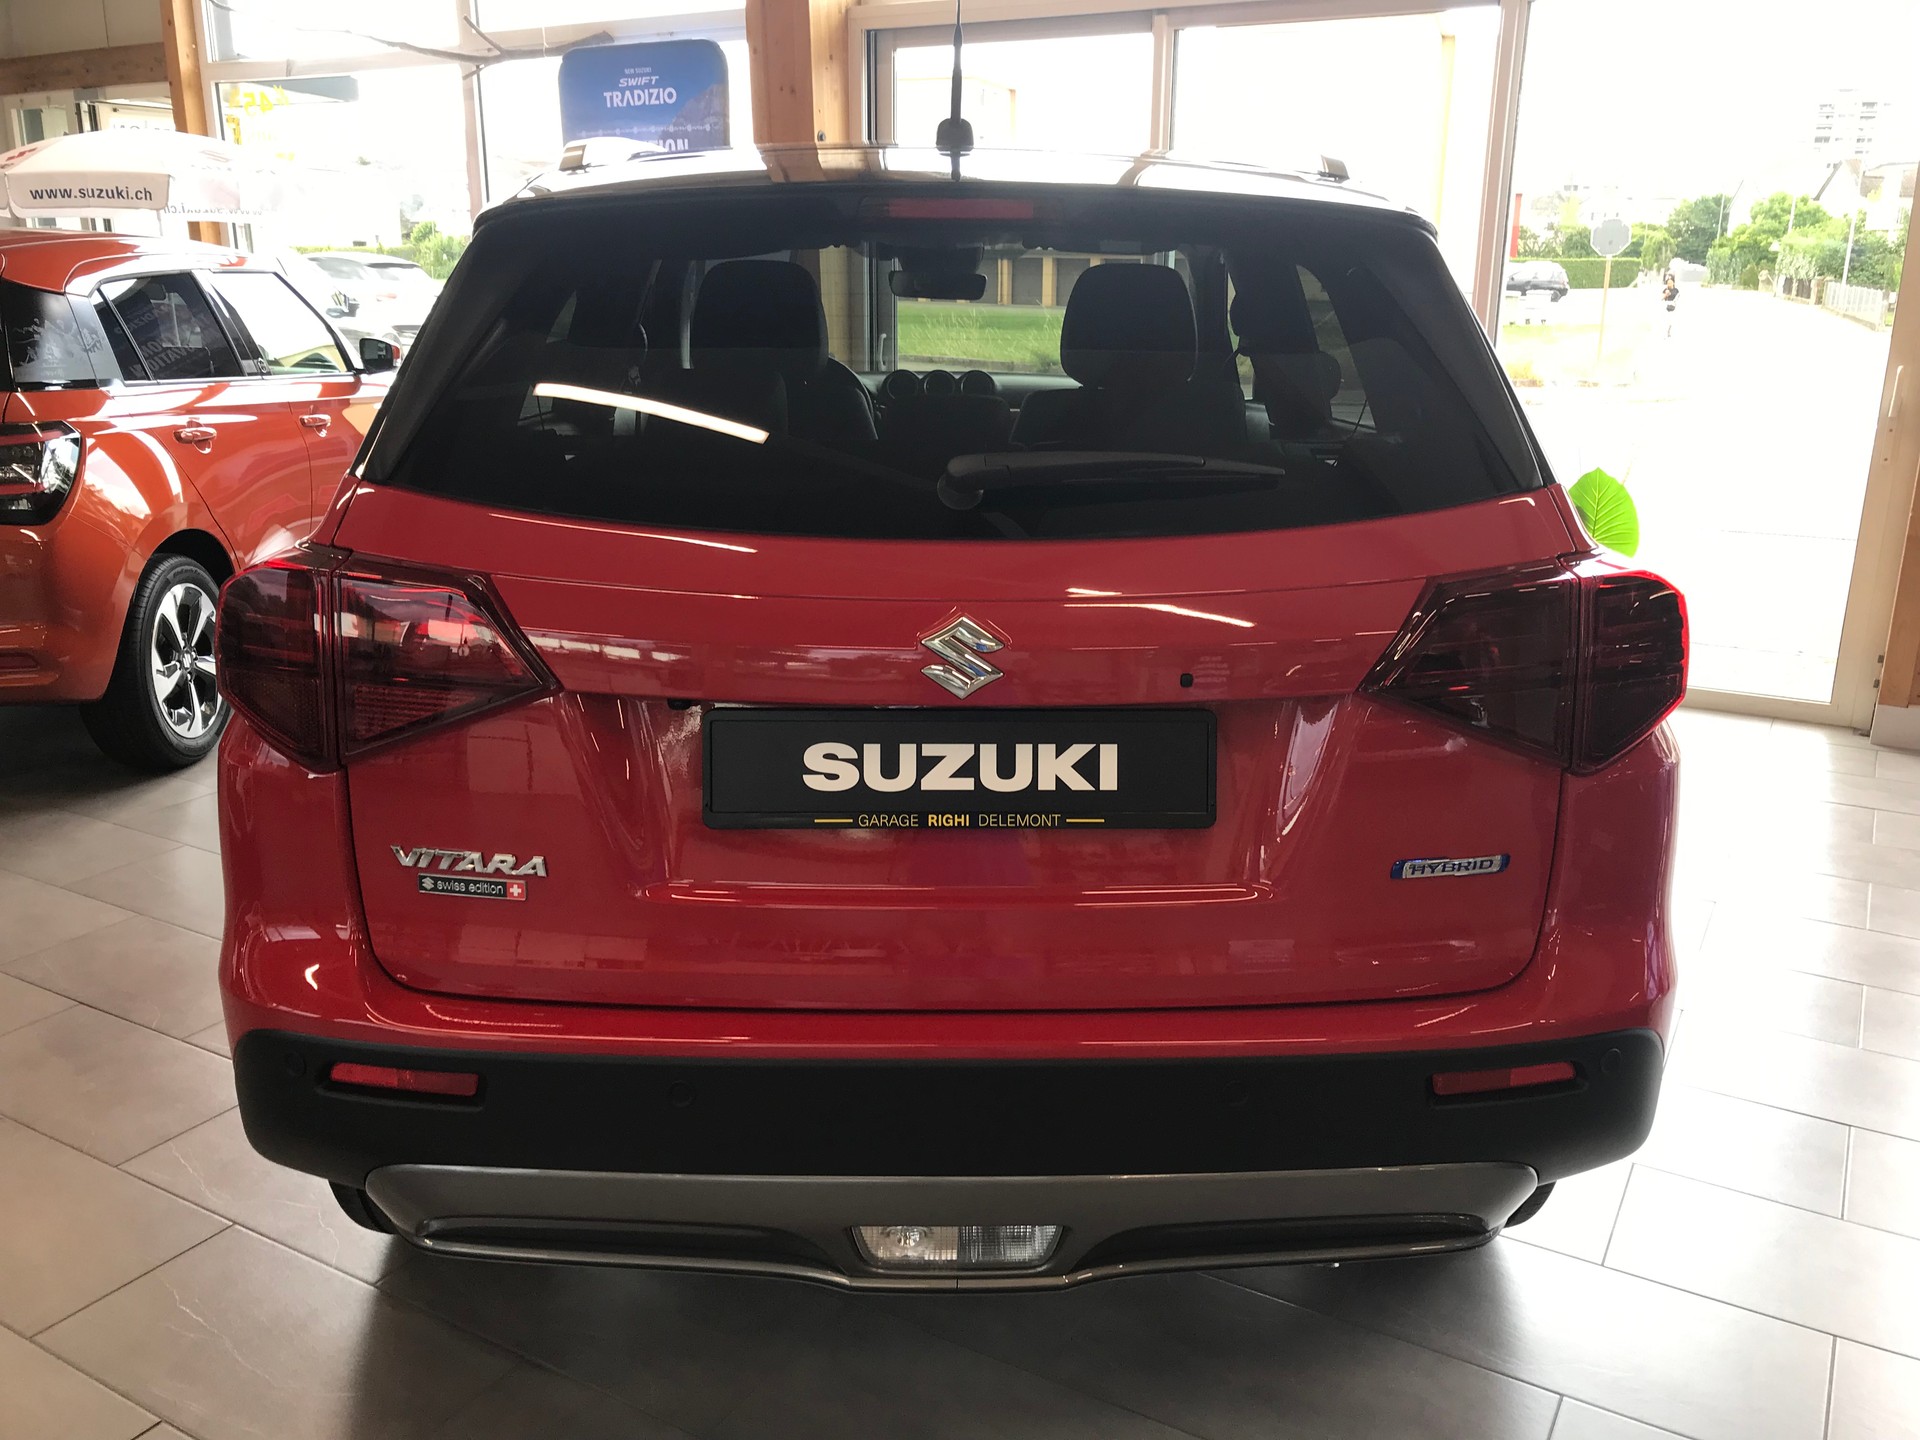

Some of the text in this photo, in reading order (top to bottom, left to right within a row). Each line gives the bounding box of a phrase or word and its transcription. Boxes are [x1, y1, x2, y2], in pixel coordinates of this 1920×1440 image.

[619, 75, 659, 87] SWIFT
[603, 87, 677, 108] TRADIZIO
[29, 185, 153, 202] www.suzuki.ch
[802, 741, 1118, 793] SUZUKI
[858, 813, 1061, 828] GARAGE RIGHI DELEMONT
[391, 844, 547, 878] VITARA
[1409, 859, 1495, 876] HYBRID
[436, 879, 504, 895] swiss edition
